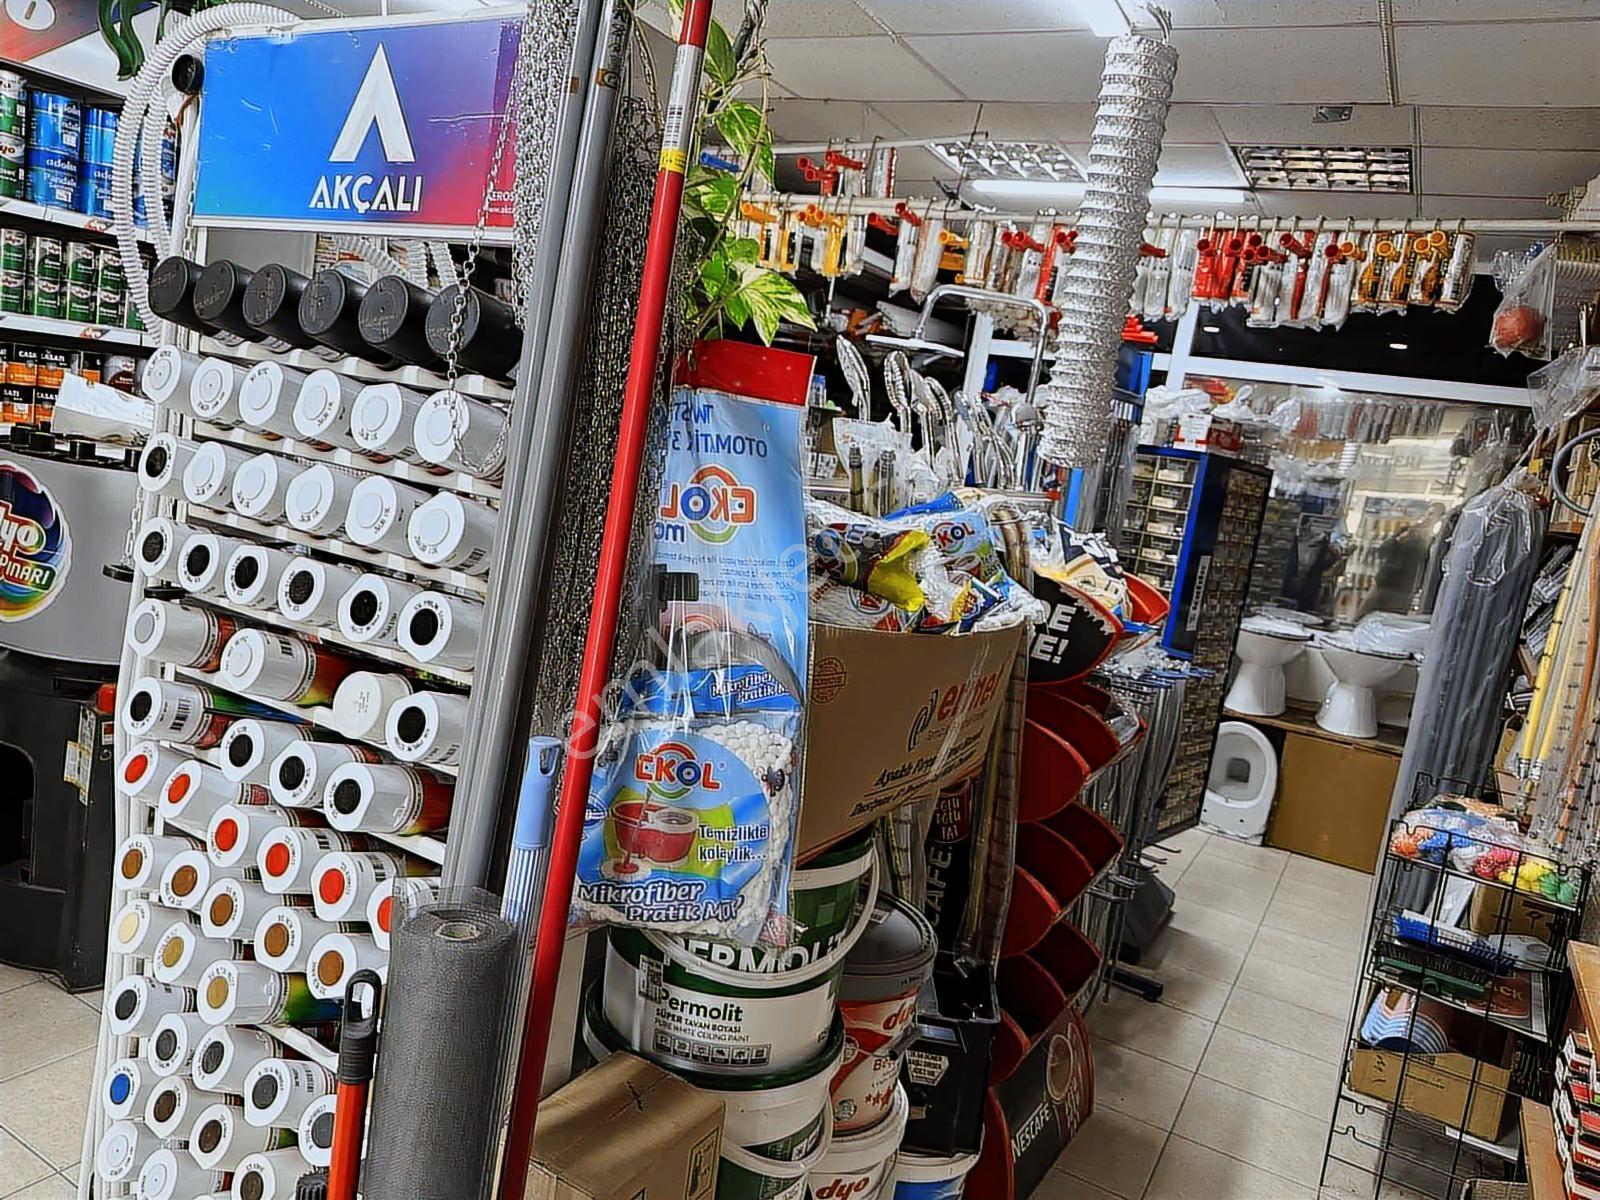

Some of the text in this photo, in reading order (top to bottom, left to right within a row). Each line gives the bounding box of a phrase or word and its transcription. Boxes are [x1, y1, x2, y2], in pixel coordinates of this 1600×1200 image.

[308, 174, 422, 214] AKÇALI
[0, 510, 38, 552] yo
[699, 823, 769, 843] Temizlikte
[579, 880, 703, 904] Mikrofiber
[628, 904, 700, 921] Pratik
